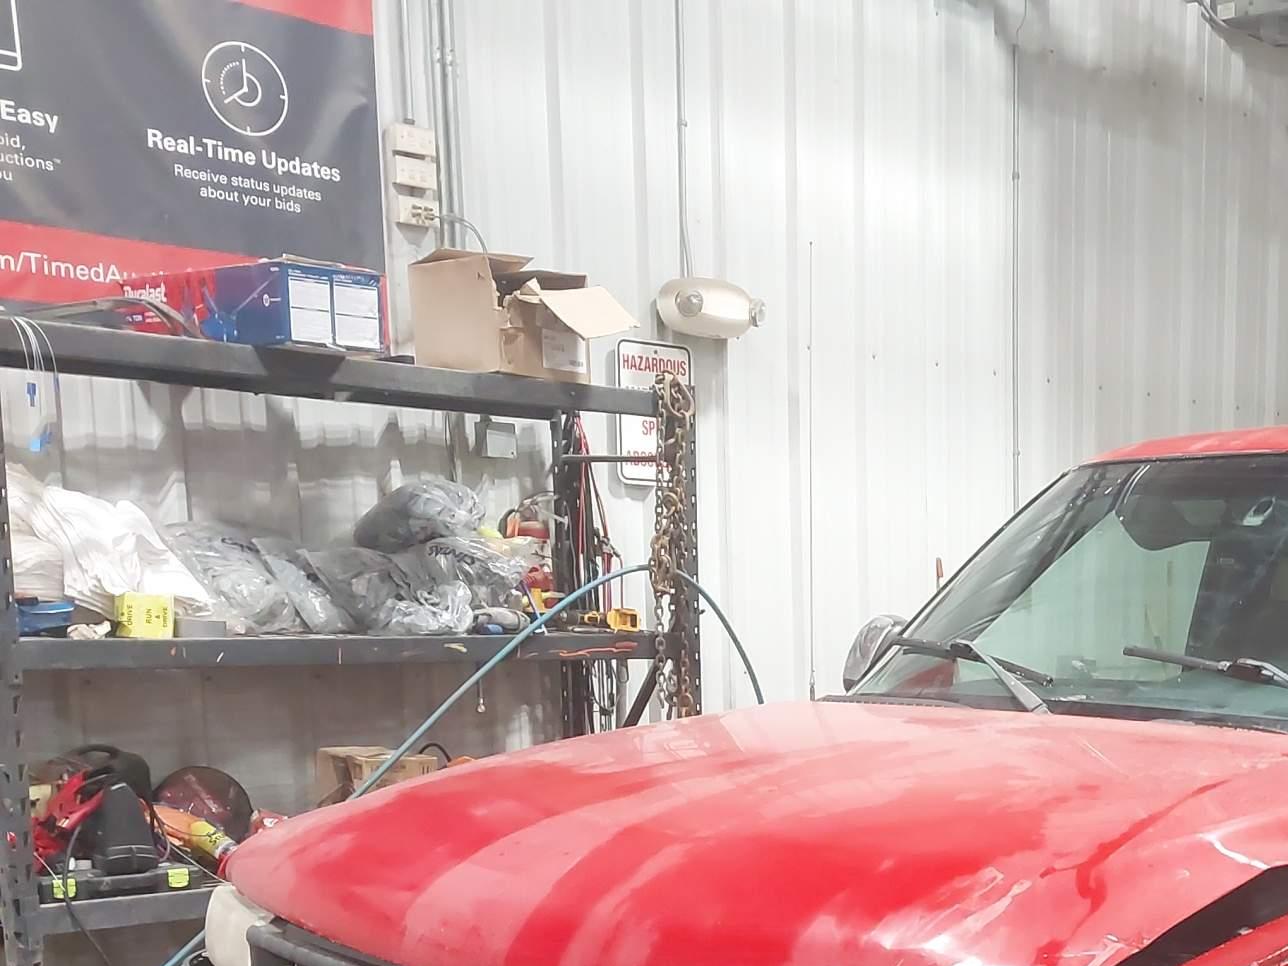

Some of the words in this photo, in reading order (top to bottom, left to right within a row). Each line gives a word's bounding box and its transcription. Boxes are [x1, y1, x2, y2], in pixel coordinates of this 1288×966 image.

[0, 99, 59, 134] Easy
[147, 128, 257, 166] Real-Time
[262, 150, 341, 182] Updates
[174, 163, 228, 185] Receive
[231, 175, 270, 192] status
[273, 183, 322, 201] updates
[200, 186, 240, 203] about
[242, 193, 272, 208] your
[274, 198, 301, 213] bids
[622, 352, 687, 377] HAZARDOUS
